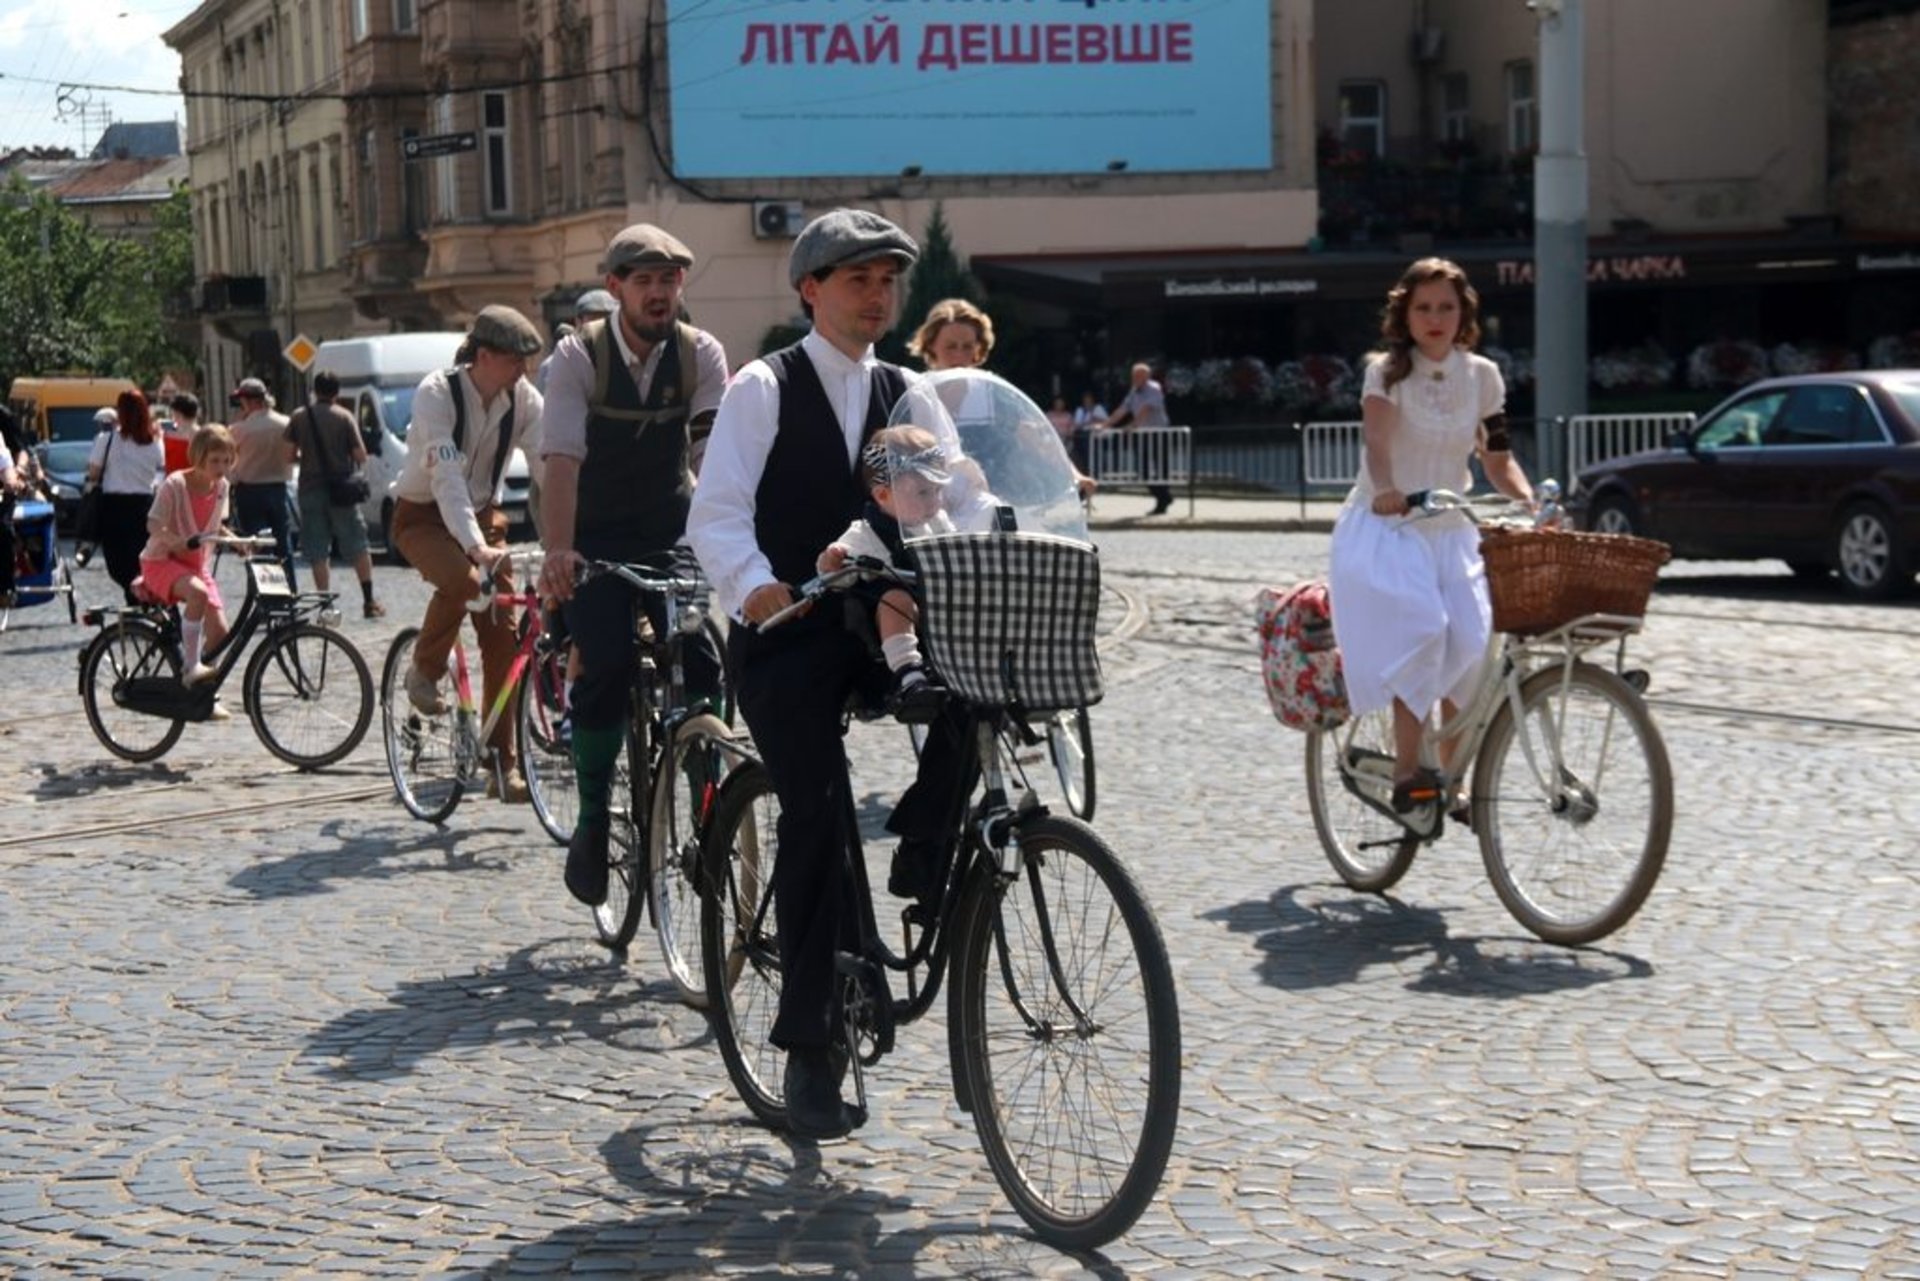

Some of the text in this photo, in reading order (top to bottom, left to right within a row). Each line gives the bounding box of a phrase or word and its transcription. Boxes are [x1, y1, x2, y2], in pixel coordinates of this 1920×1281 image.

[740, 16, 1193, 70] ЛІТАЙ ДЕШЕВШЕ
[1611, 255, 1686, 280] ЧАРКА
